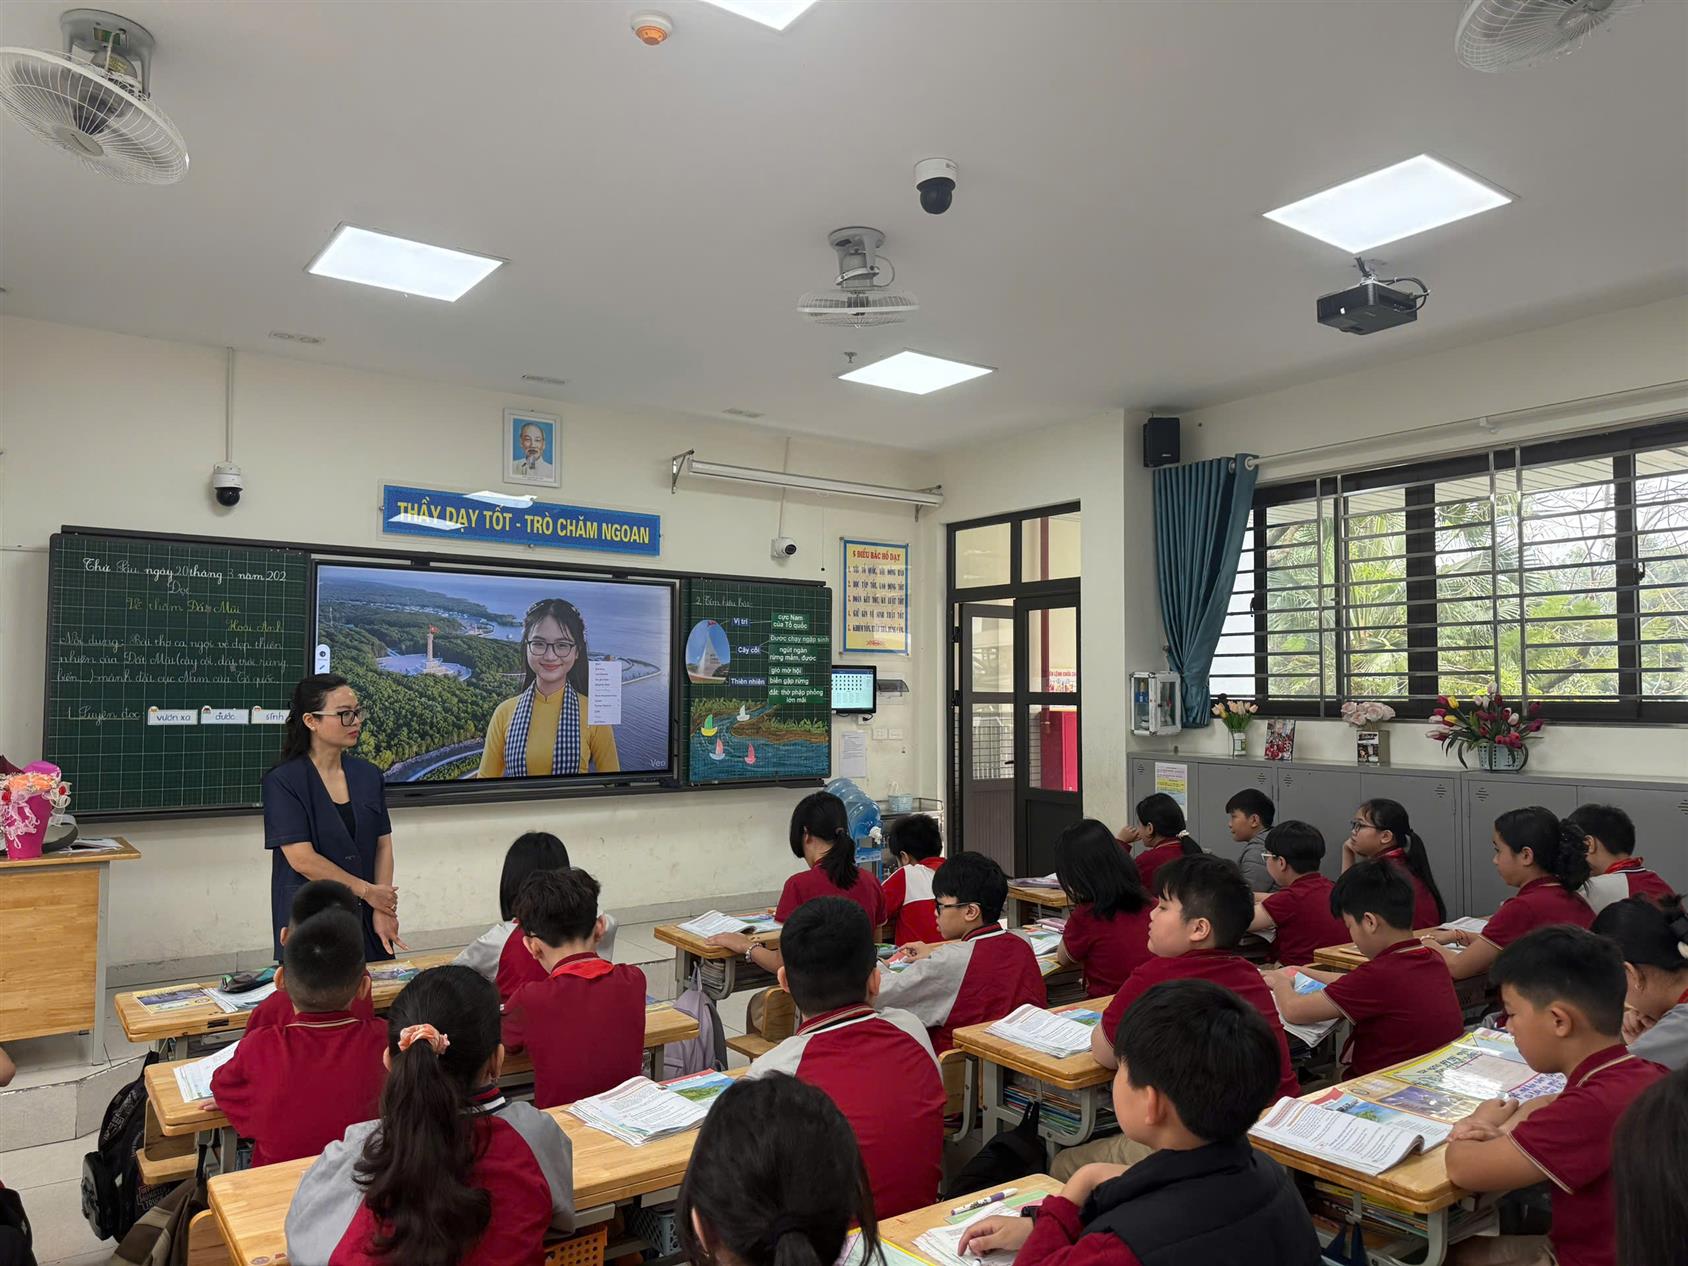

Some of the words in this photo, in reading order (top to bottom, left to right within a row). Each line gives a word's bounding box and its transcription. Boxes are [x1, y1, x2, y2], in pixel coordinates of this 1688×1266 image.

[398, 497, 441, 521] THẦY
[445, 507, 479, 533] DẠY
[484, 504, 512, 531] TỐT
[525, 513, 552, 535] TRÒ
[557, 515, 598, 539] CHĂM
[602, 523, 649, 544] NGOAN
[83, 557, 112, 573] Thứ
[144, 567, 174, 583] ngày
[189, 564, 223, 585] tháng
[238, 570, 265, 581] năm
[265, 570, 287, 582] 202
[737, 646, 750, 655] Cây
[649, 759, 666, 768] Veo
